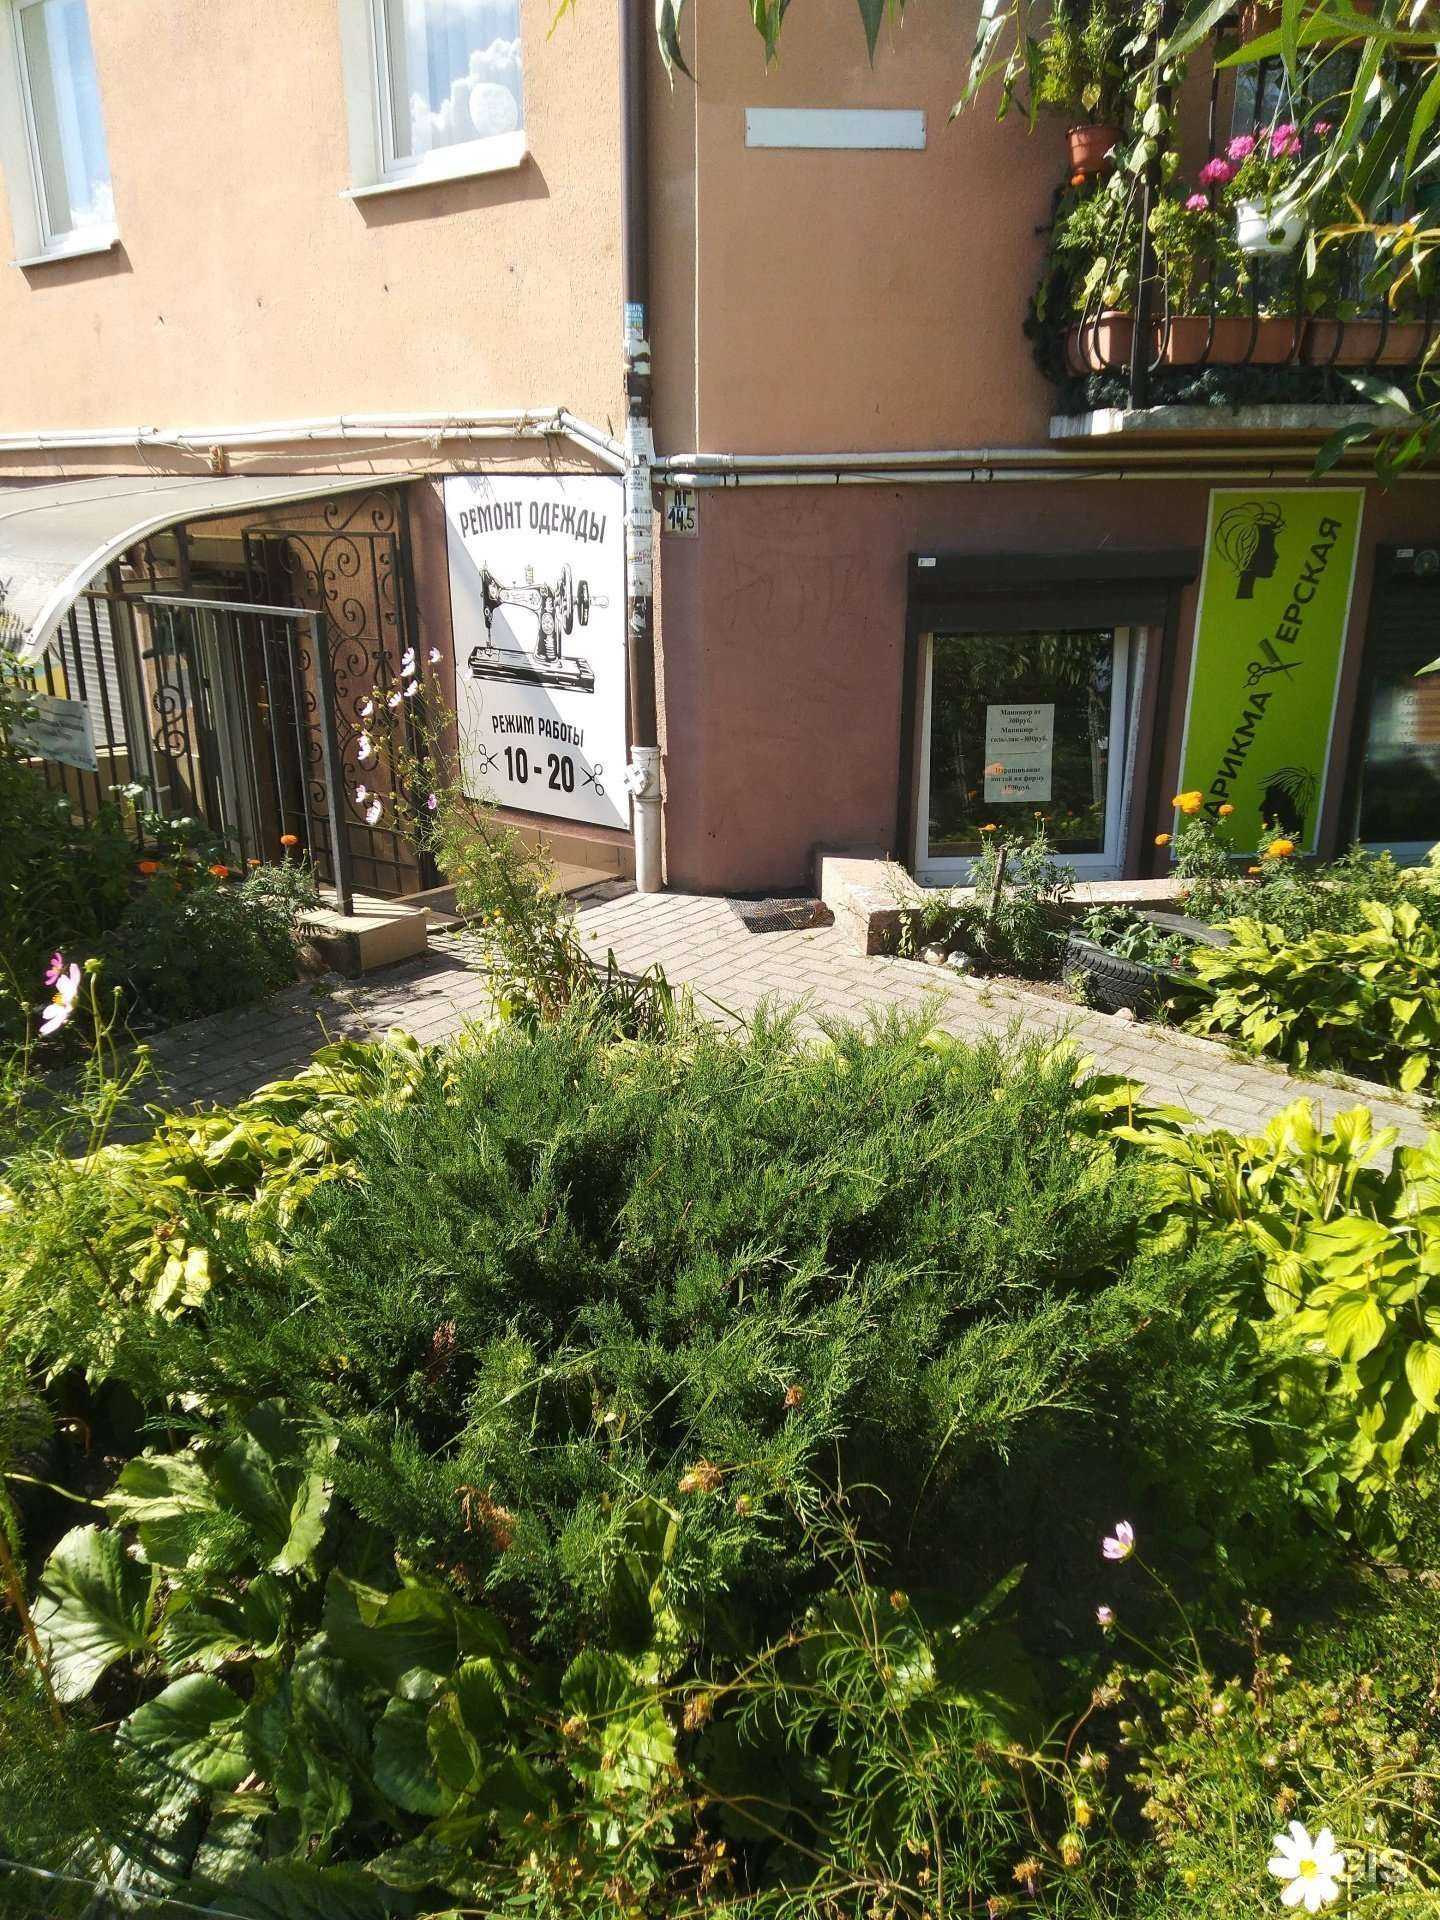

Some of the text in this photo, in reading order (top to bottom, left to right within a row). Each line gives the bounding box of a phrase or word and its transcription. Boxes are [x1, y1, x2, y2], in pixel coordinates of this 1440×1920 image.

[674, 489, 692, 506] ПГ
[460, 501, 607, 543] РЕМОНТ ОДЕЖДЫ
[492, 714, 584, 748] РЕЖИМ РАБОТЫ
[504, 746, 528, 784] 10
[548, 753, 575, 793] 20
